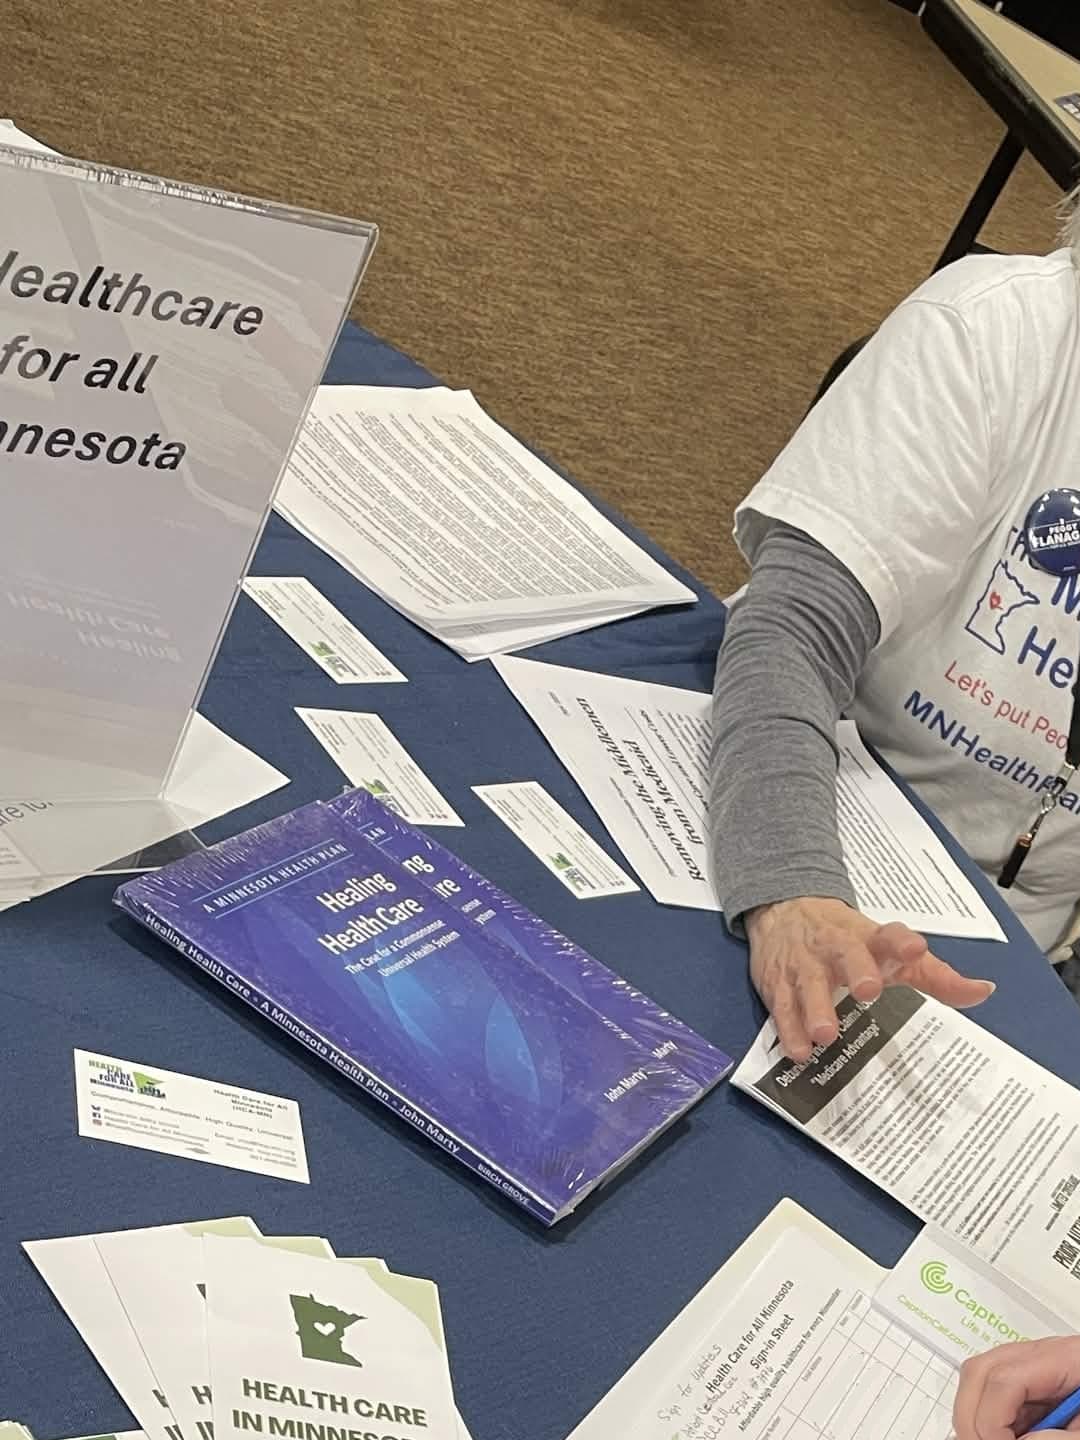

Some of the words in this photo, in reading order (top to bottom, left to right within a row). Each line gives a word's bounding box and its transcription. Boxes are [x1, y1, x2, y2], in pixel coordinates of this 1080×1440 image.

[0, 335, 80, 382] for
[84, 352, 159, 394] all
[0, 420, 187, 470] nesota
[1049, 523, 1078, 534] PEGGY
[944, 660, 993, 706] Let's
[994, 698, 1029, 730] put
[576, 697, 635, 780] Middlemen
[623, 739, 675, 807] Medicaid
[632, 778, 655, 810] the
[653, 805, 706, 882] Removing
[674, 807, 704, 845] from
[203, 903, 215, 913] A
[214, 873, 279, 908] MINNESOTA
[279, 855, 319, 881] HEALTH
[319, 842, 348, 865] PLAN
[316, 873, 397, 912] Healing
[317, 914, 388, 955] Health
[376, 898, 424, 926] Care
[344, 961, 363, 975] The
[362, 951, 381, 969] Case
[146, 914, 187, 951] Healing
[188, 947, 224, 979] Health
[225, 973, 251, 998] Care
[260, 1000, 271, 1014] A
[271, 1009, 329, 1056] Minnesota
[329, 1049, 366, 1082] Health
[364, 1078, 391, 1101] Plan
[399, 1103, 427, 1127] John
[424, 1120, 460, 1153] Marty
[477, 1162, 503, 1186] BIRCH
[501, 1180, 531, 1205] GROVE
[652, 1040, 678, 1060] Marty
[604, 1080, 627, 1103] John
[620, 1067, 649, 1091] Marty
[1052, 1237, 1077, 1270] PRIOR
[705, 1361, 732, 1394] Health
[728, 1343, 745, 1364] Care
[742, 1331, 756, 1347] for
[753, 1317, 766, 1333] All
[762, 1280, 794, 1321] Minnesota
[750, 1338, 777, 1370] Sign-in
[773, 1313, 795, 1340] Sheet
[960, 1316, 980, 1335] Life
[981, 1329, 991, 1342] is
[242, 1378, 349, 1414] HEALTH
[354, 1398, 429, 1427] CARE
[738, 1401, 763, 1432] Affordable
[769, 1368, 787, 1392] quality
[782, 1337, 806, 1371] healthcare
[232, 1409, 263, 1433] IN
